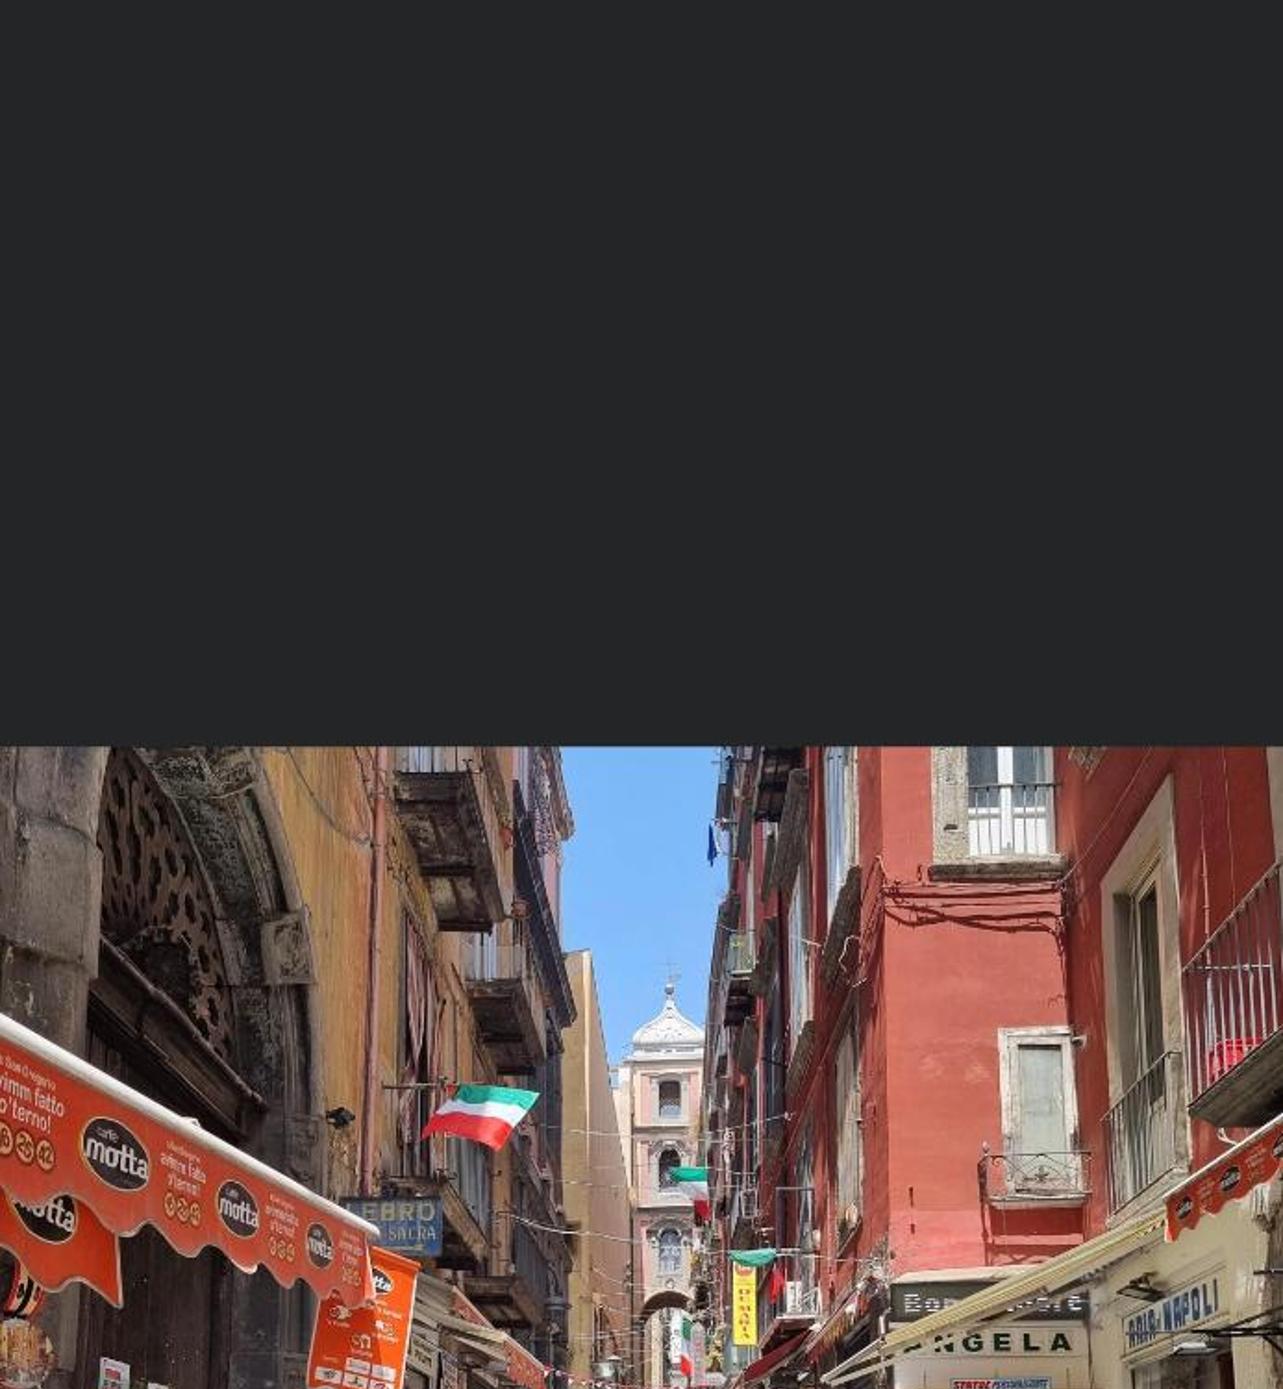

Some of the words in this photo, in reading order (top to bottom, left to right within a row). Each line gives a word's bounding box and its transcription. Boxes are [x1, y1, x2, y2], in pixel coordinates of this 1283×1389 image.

[34, 1087, 65, 1118] fatto
[86, 1138, 148, 1180] motta
[28, 1198, 75, 1233] otta
[220, 1198, 259, 1228] motta
[1162, 1277, 1219, 1331] NAPOLI
